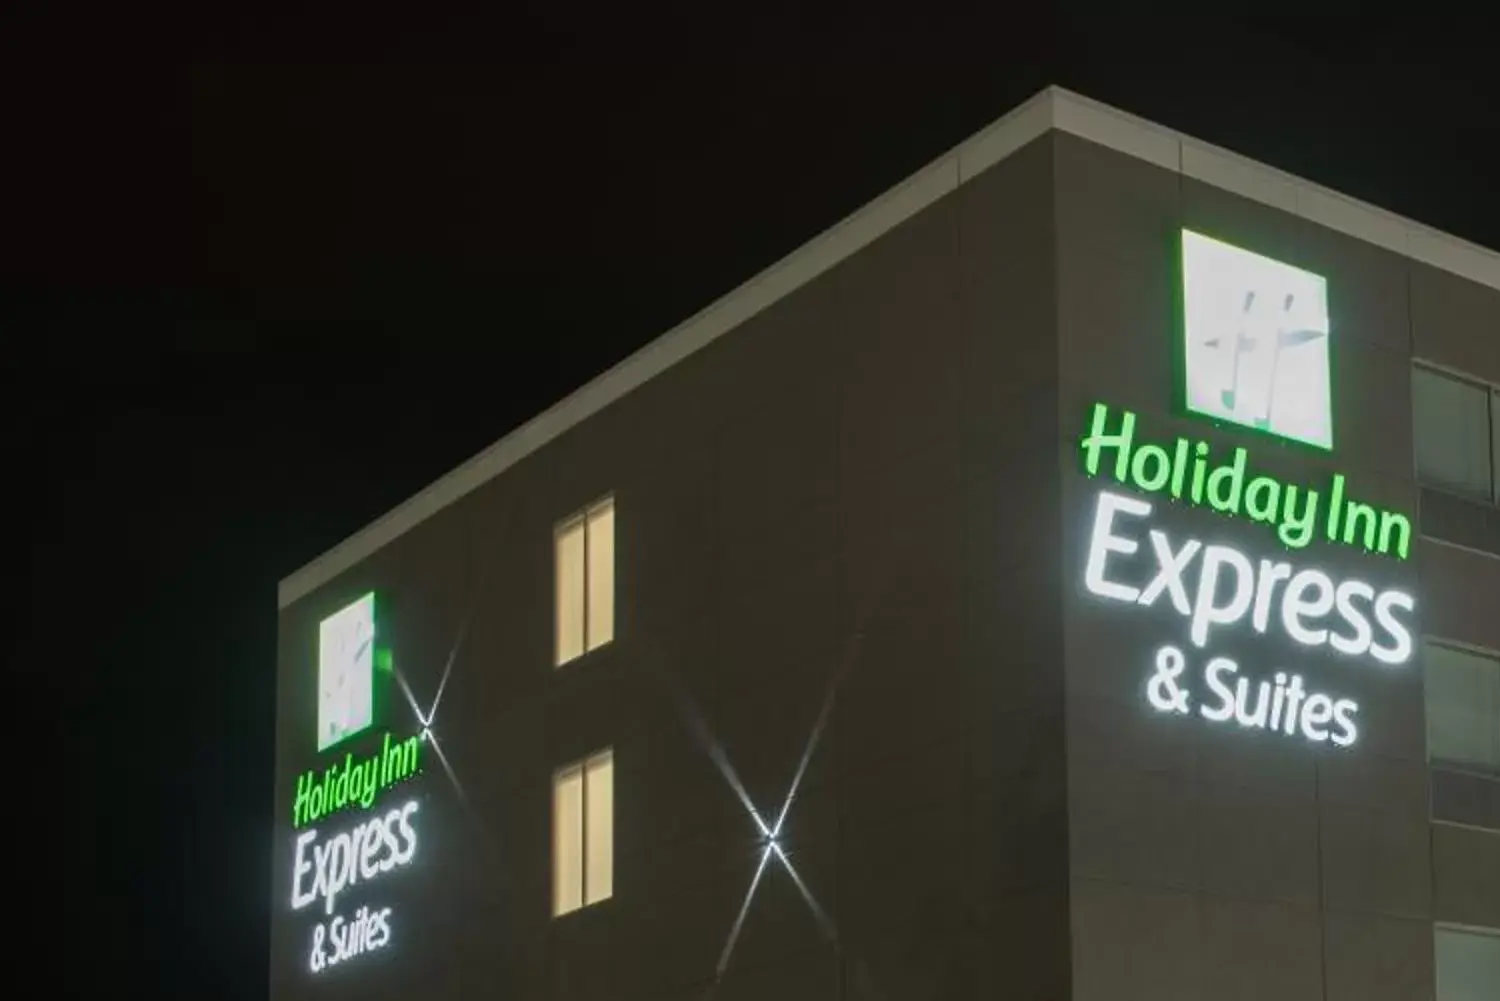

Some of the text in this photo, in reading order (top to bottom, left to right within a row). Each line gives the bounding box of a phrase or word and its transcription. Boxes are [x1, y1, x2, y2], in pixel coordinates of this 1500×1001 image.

[1081, 403, 1412, 559] Holiday Inn
[1085, 491, 1415, 664] Express
[1147, 645, 1359, 747] & Suites
[293, 732, 418, 828] Holiday Inn
[290, 801, 420, 914] Express
[309, 905, 392, 973] & Suites
